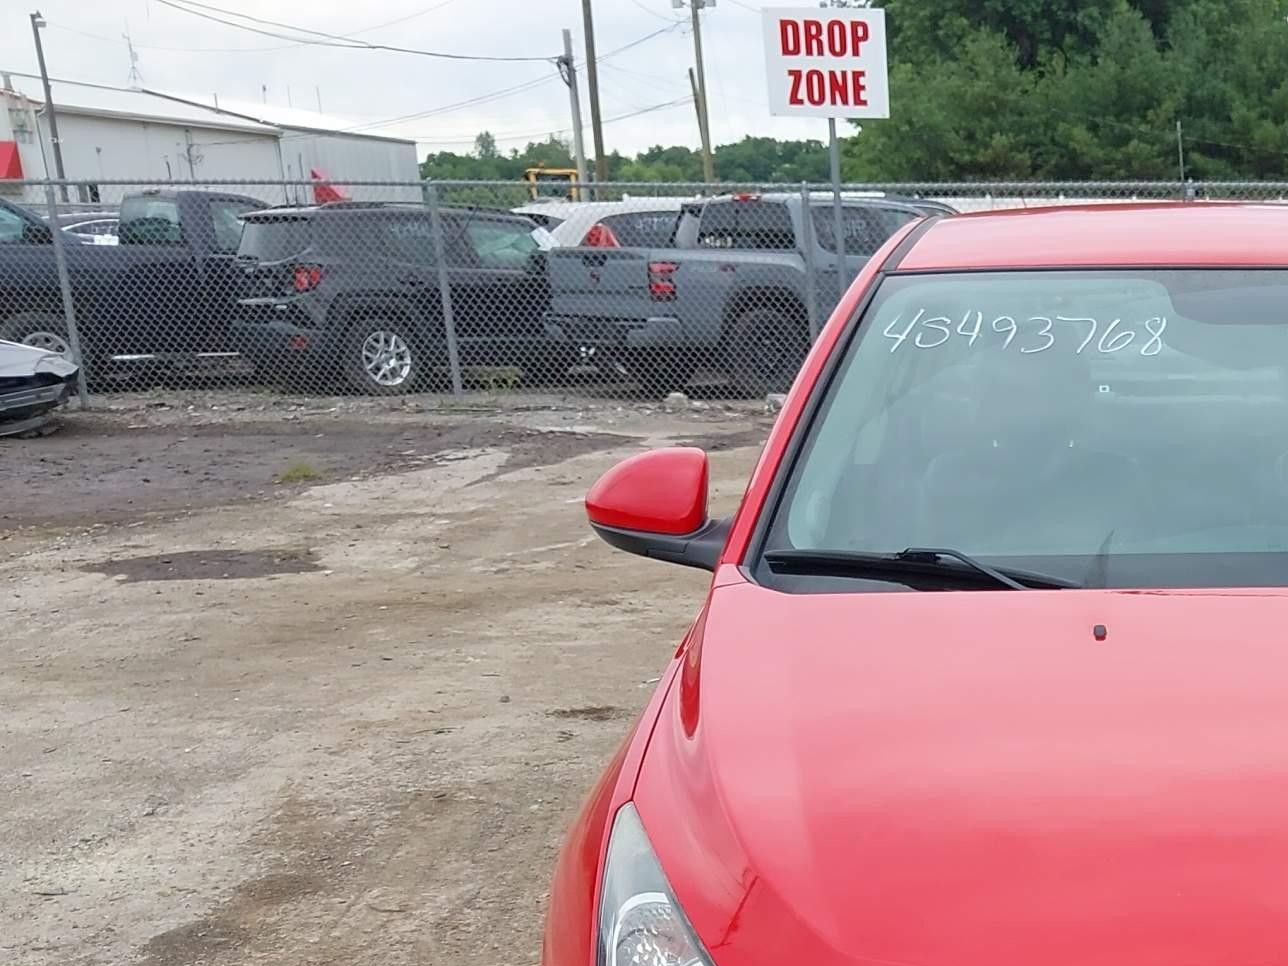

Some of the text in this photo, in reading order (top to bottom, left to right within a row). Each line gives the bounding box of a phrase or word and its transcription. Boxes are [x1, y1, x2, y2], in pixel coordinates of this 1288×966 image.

[779, 19, 869, 57] DROP
[787, 69, 868, 106] ZONE
[883, 308, 1167, 355] 45493768
